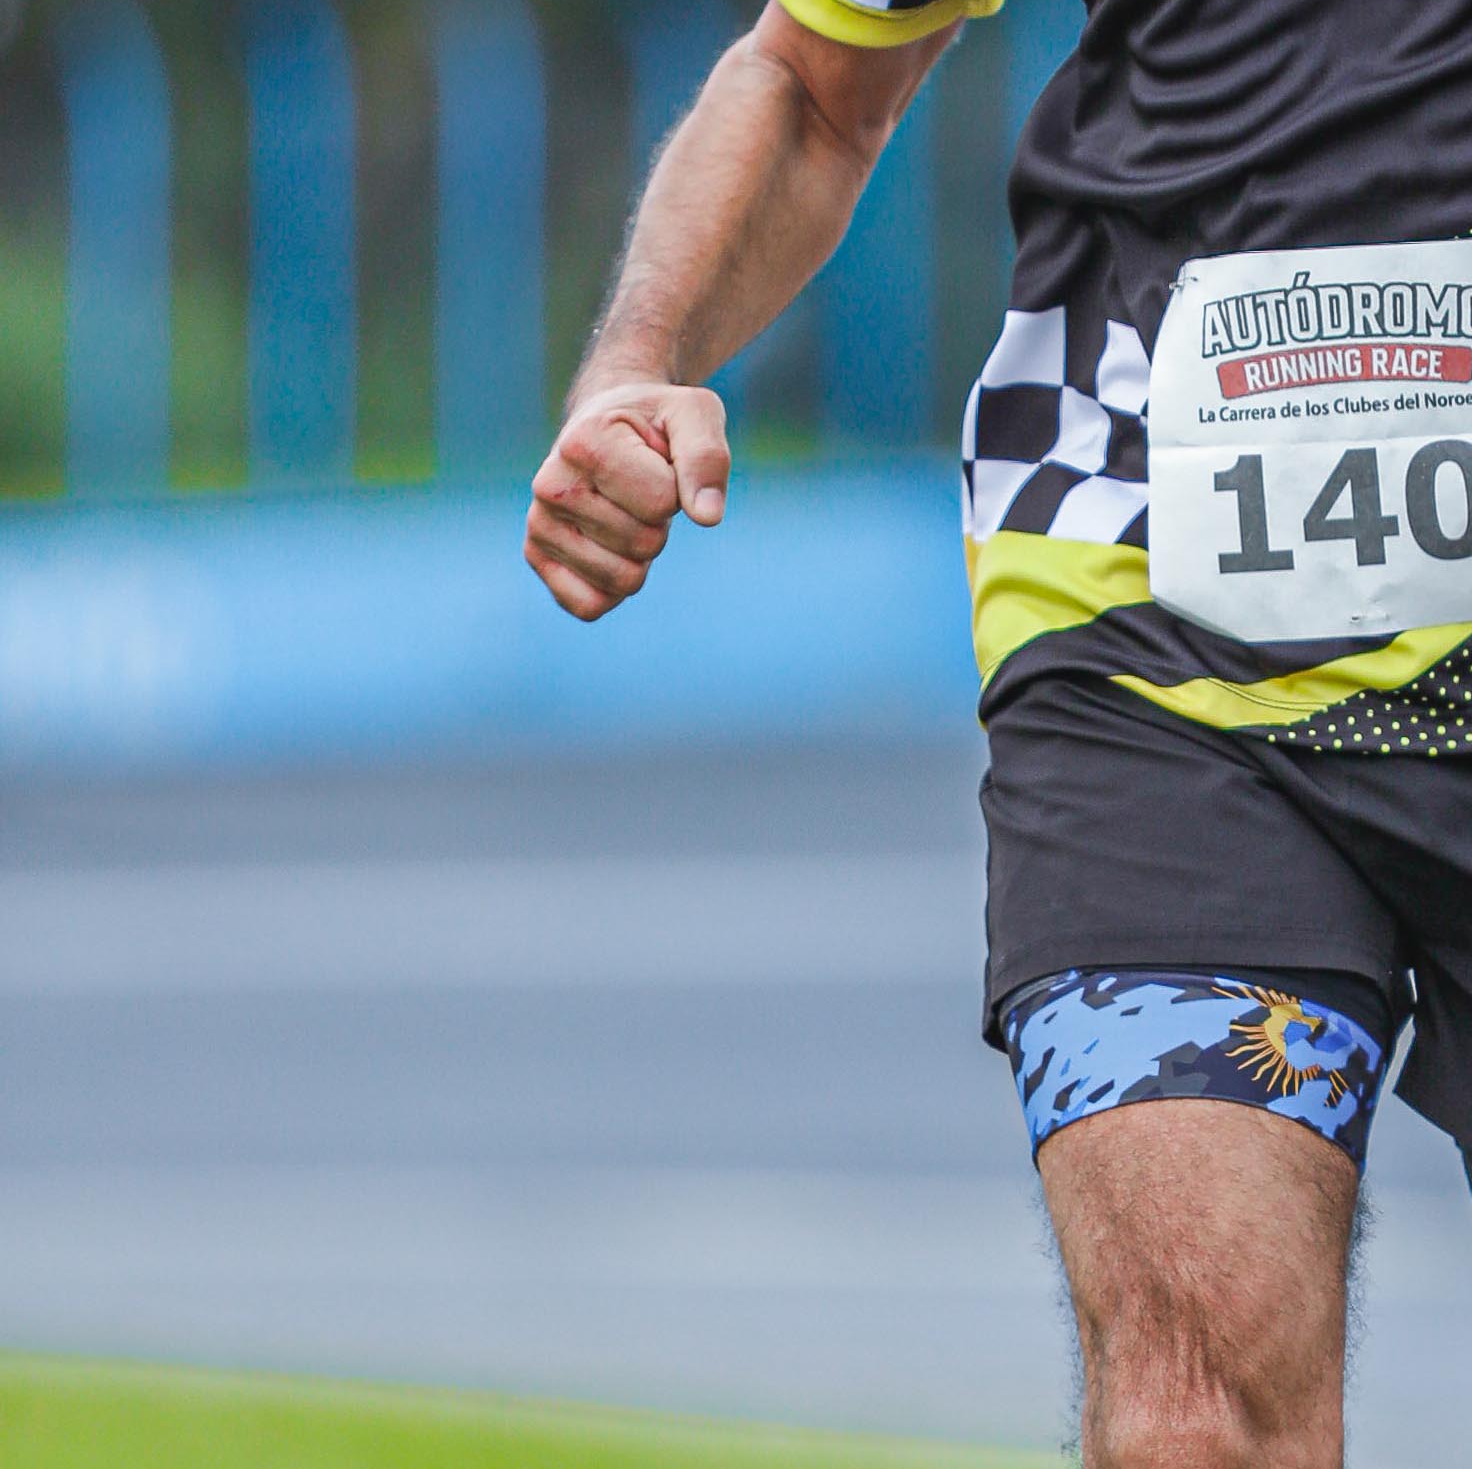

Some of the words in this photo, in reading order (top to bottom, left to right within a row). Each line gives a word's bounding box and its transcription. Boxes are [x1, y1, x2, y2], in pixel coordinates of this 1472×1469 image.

[1243, 348, 1362, 392] RUNNING
[1371, 347, 1444, 379] RACE
[1199, 407, 1216, 423] La
[1219, 403, 1276, 422] Carrera
[1280, 401, 1301, 418] de
[1305, 399, 1330, 416] los
[1333, 396, 1390, 414] Clubes
[1394, 393, 1420, 411] del
